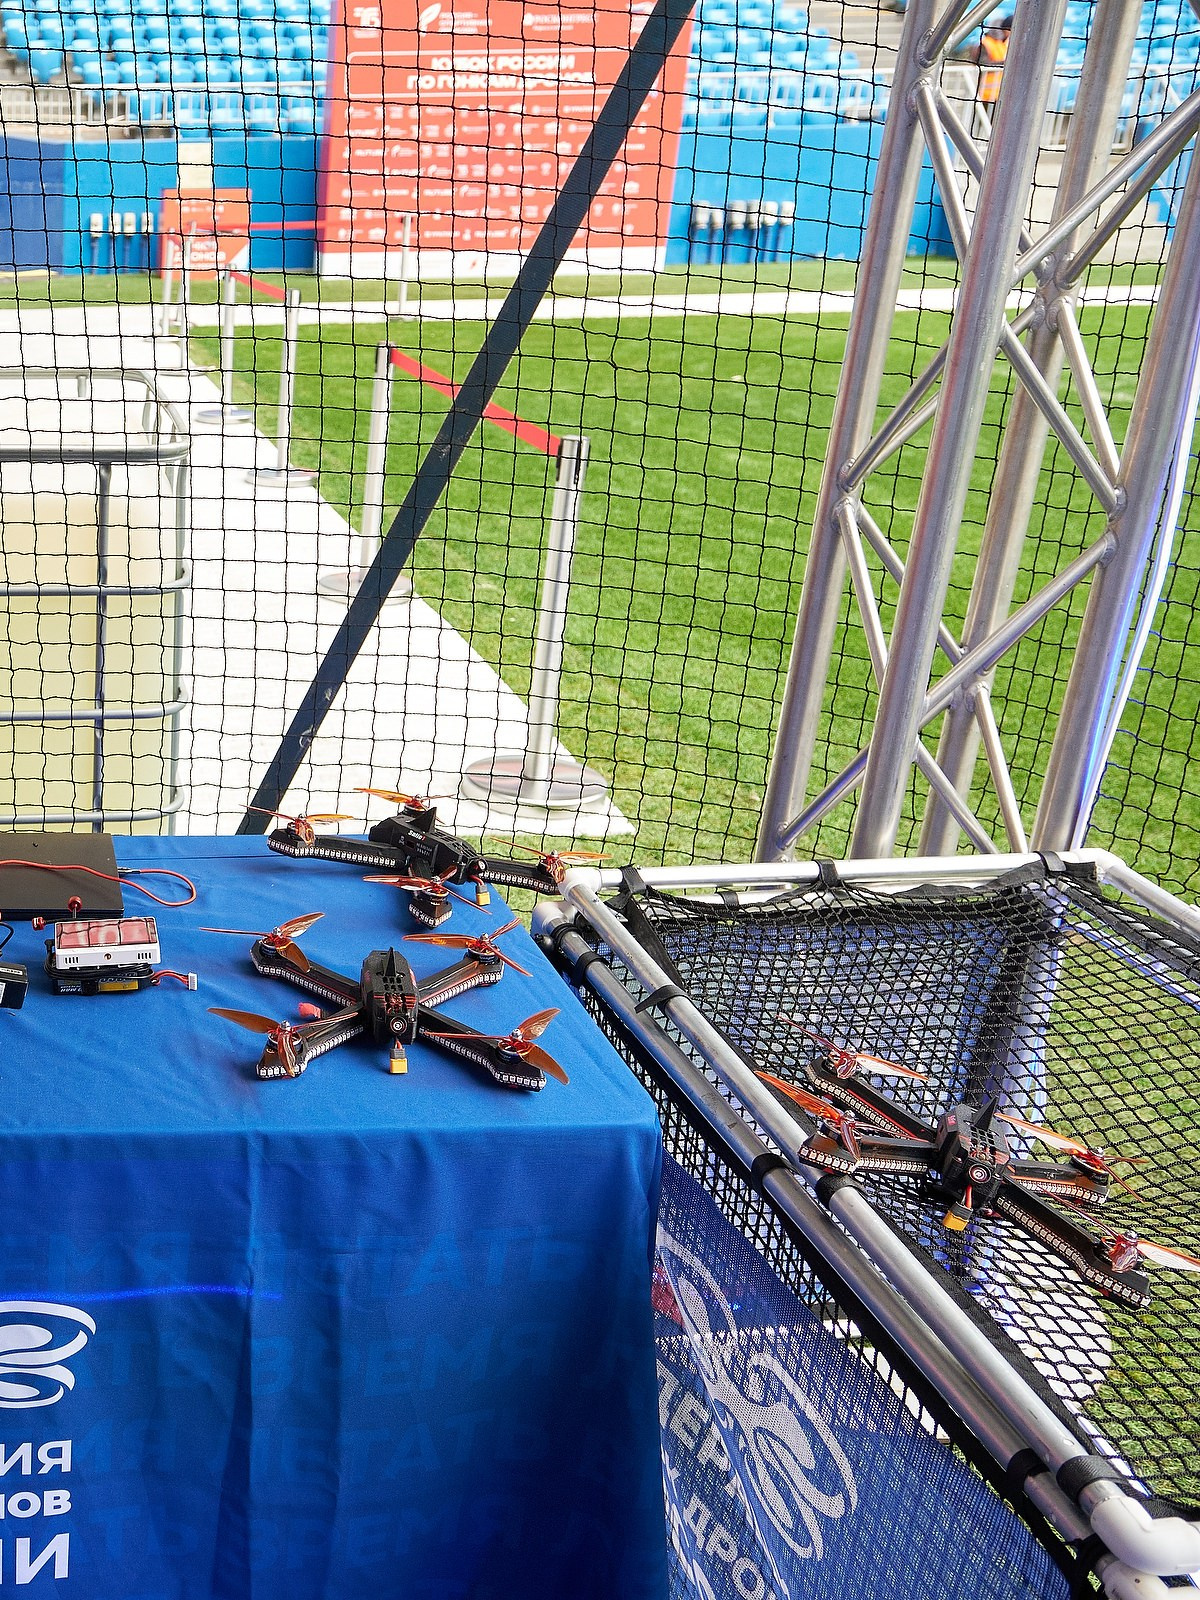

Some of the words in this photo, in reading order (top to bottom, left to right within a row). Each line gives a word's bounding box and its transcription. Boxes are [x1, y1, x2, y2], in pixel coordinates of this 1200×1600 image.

[497, 54, 576, 71] РОССИИ
[407, 74, 436, 90] ПО
[437, 73, 516, 91] ГОНКАМ
